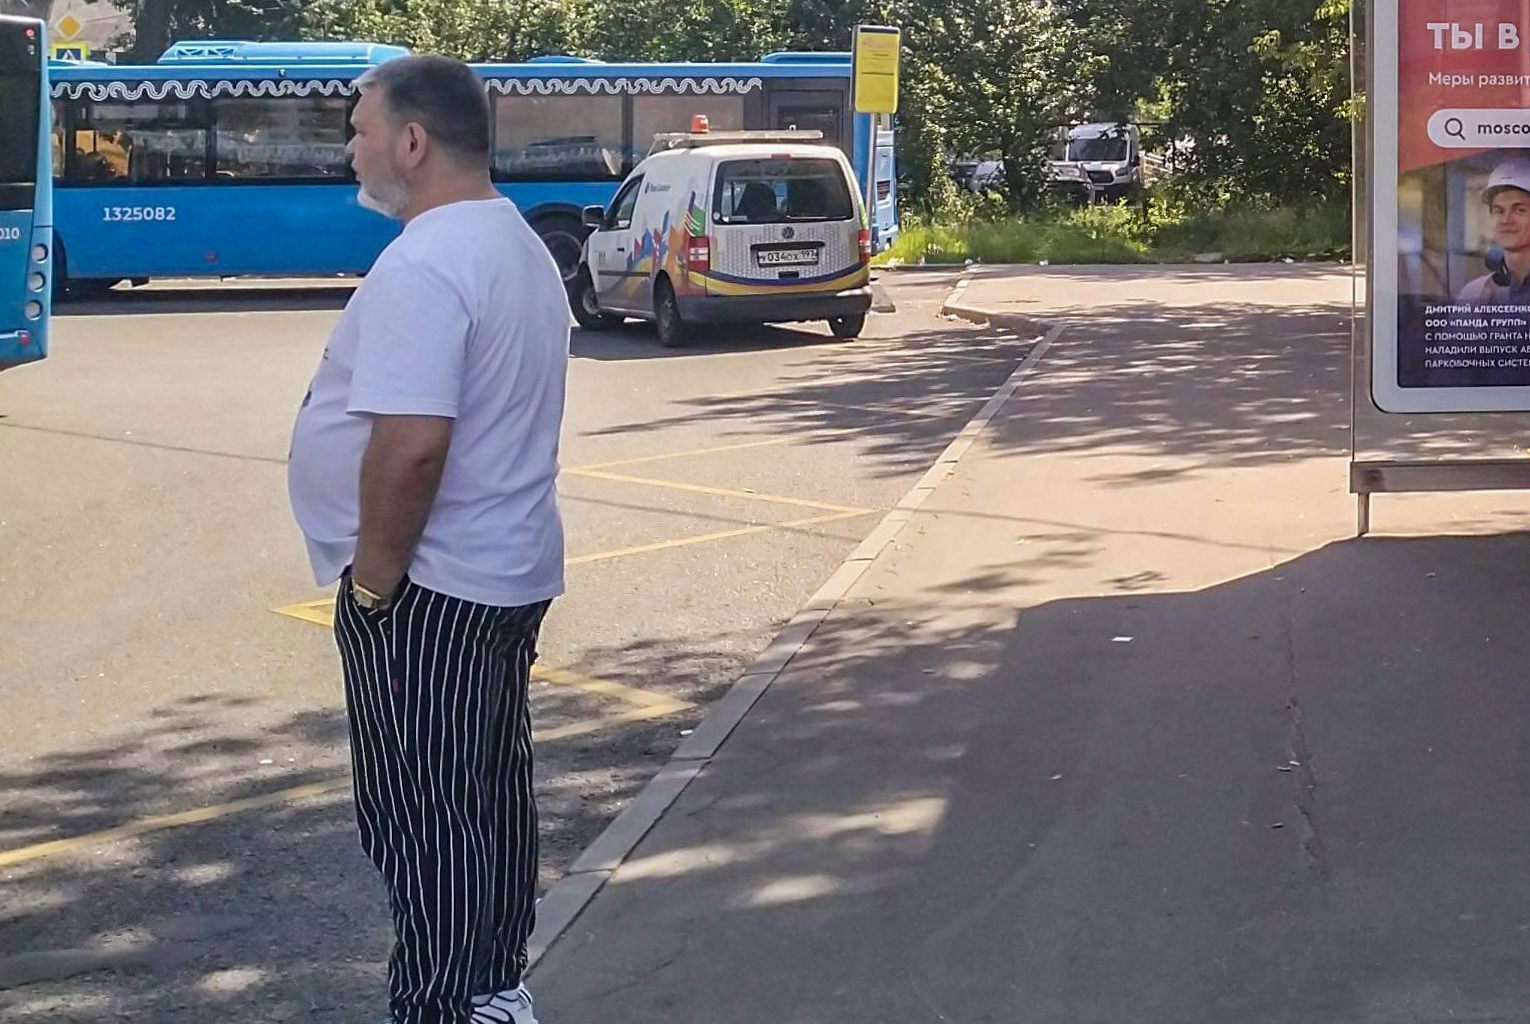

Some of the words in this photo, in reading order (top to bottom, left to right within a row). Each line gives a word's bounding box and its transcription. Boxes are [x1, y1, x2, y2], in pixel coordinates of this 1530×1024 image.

[1426, 23, 1484, 50] ТЫ
[1498, 23, 1520, 50] В
[1428, 71, 1474, 88] Меры
[103, 207, 176, 221] 1325082
[1425, 304, 1472, 315] ДМИТРИЙ
[1425, 319, 1448, 327] ООО
[1450, 319, 1488, 328] «ПАНДА
[1491, 318, 1527, 327] ГРУПП»
[1425, 332, 1432, 341] С
[1435, 332, 1487, 341] ПОМОЩЬЮ
[1490, 332, 1523, 340] ГРАНТА
[1425, 346, 1477, 354] НАЛАДИЛИ
[1479, 345, 1518, 354] ВЫПУСК
[1425, 359, 1496, 368] ПАРКОВОЧНЫХ
